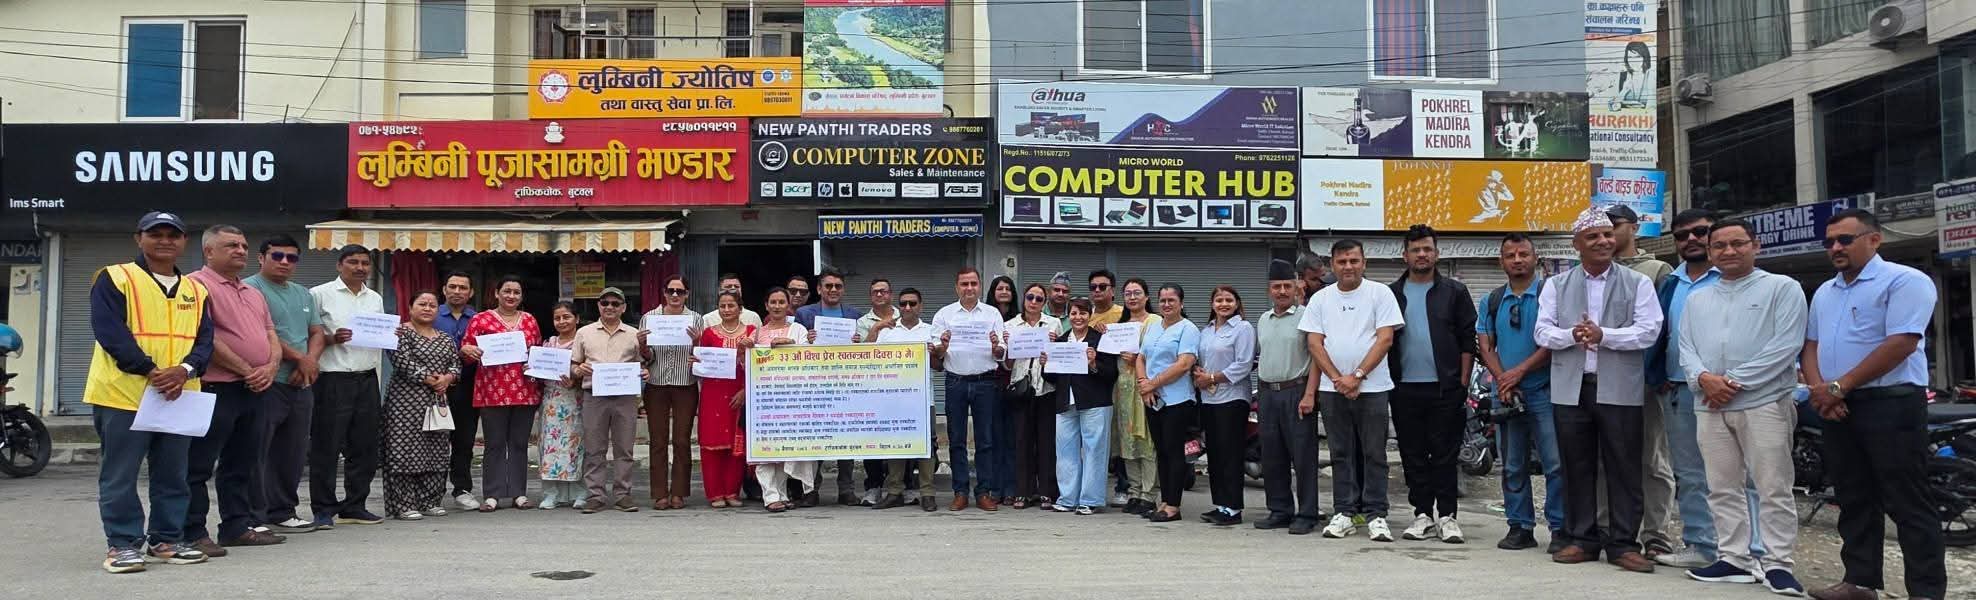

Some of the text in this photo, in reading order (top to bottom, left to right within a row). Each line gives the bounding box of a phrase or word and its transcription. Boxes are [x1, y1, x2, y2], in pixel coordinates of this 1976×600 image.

[578, 65, 755, 94] लुम्बिनी ज्योतिष
[601, 99, 626, 110] तथा
[631, 99, 663, 112] वास्तु
[667, 96, 692, 110] सेवा
[1422, 98, 1474, 113] POKHREL
[759, 124, 932, 135] NEW PANTHI TRADERS
[1426, 117, 1470, 131] MADIRA
[1425, 135, 1471, 149] KENDRA
[357, 141, 471, 187] लुम्बिनी
[636, 147, 737, 181] भण्डार
[792, 148, 985, 165] COMPUTER ZONE
[1120, 158, 1184, 167] MICRO WORLD
[75, 150, 275, 182] SAMSUNG
[889, 168, 985, 177] Sales & Maintenance
[1004, 165, 1296, 197] COMPUTER HUB
[10, 198, 65, 208] Ims Smart
[823, 220, 845, 235] NEW
[849, 220, 882, 234] PANTHI
[886, 219, 931, 234] TRADERS
